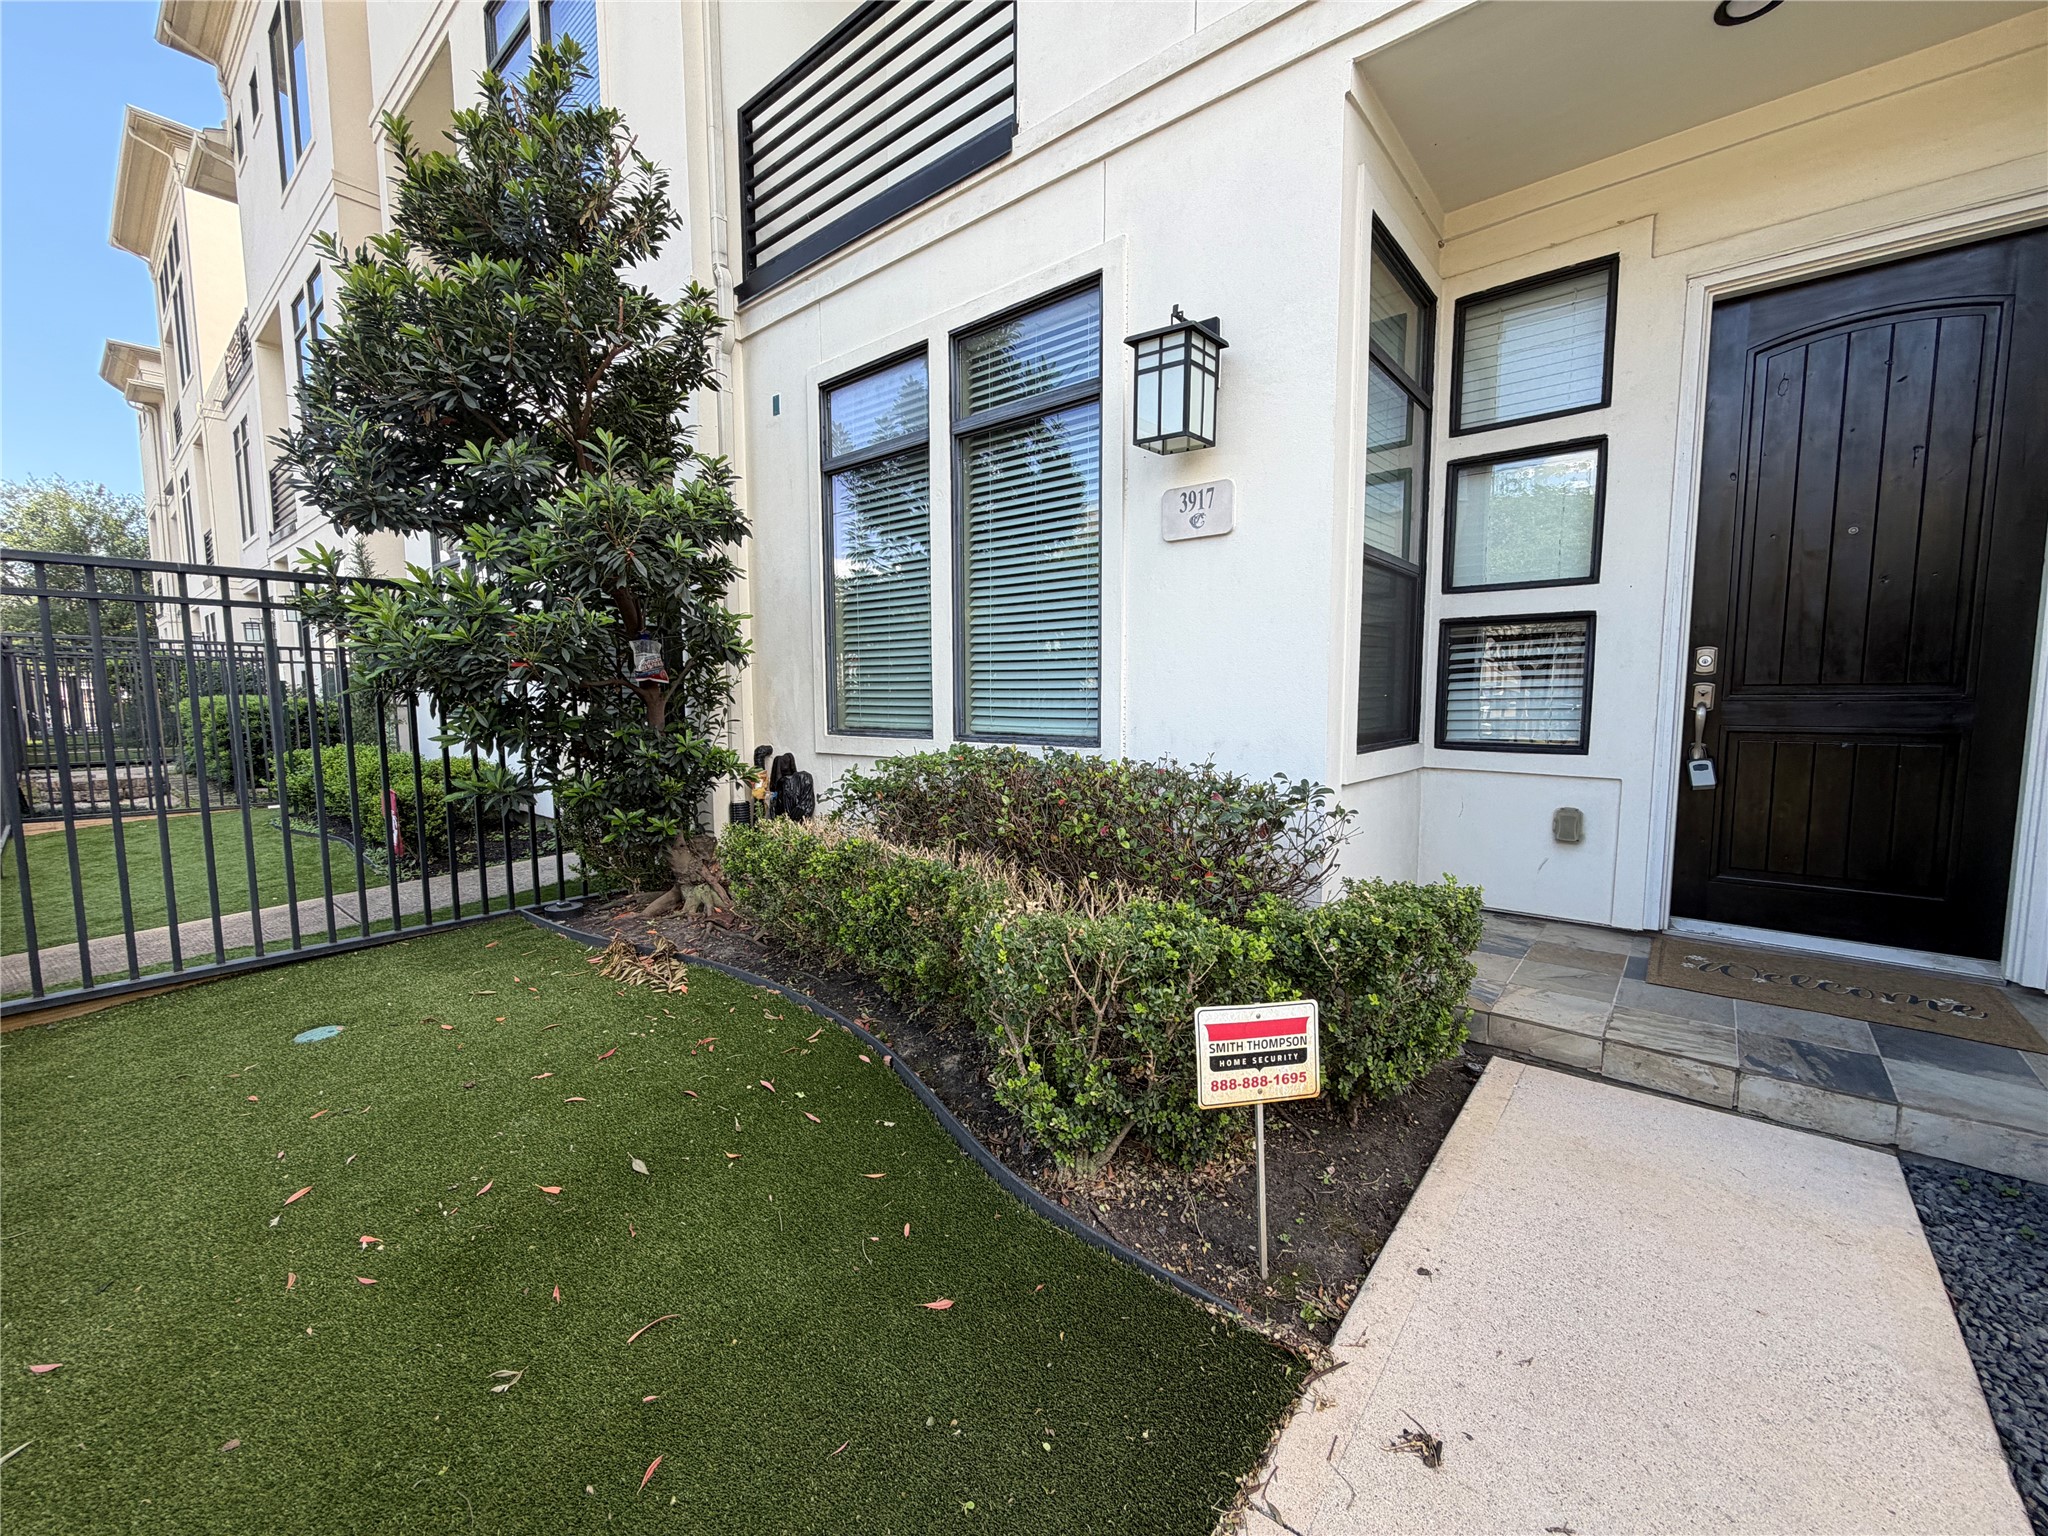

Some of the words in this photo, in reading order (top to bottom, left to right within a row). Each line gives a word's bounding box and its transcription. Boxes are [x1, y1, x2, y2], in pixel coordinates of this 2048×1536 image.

[1180, 487, 1214, 513] 3917
[1209, 1041, 1243, 1054] SMITH
[1247, 1035, 1307, 1051] THOMPSON
[1219, 1058, 1247, 1067] HOME
[1252, 1053, 1299, 1064] SECURITY
[1211, 1072, 1307, 1092] 888-888-1695
